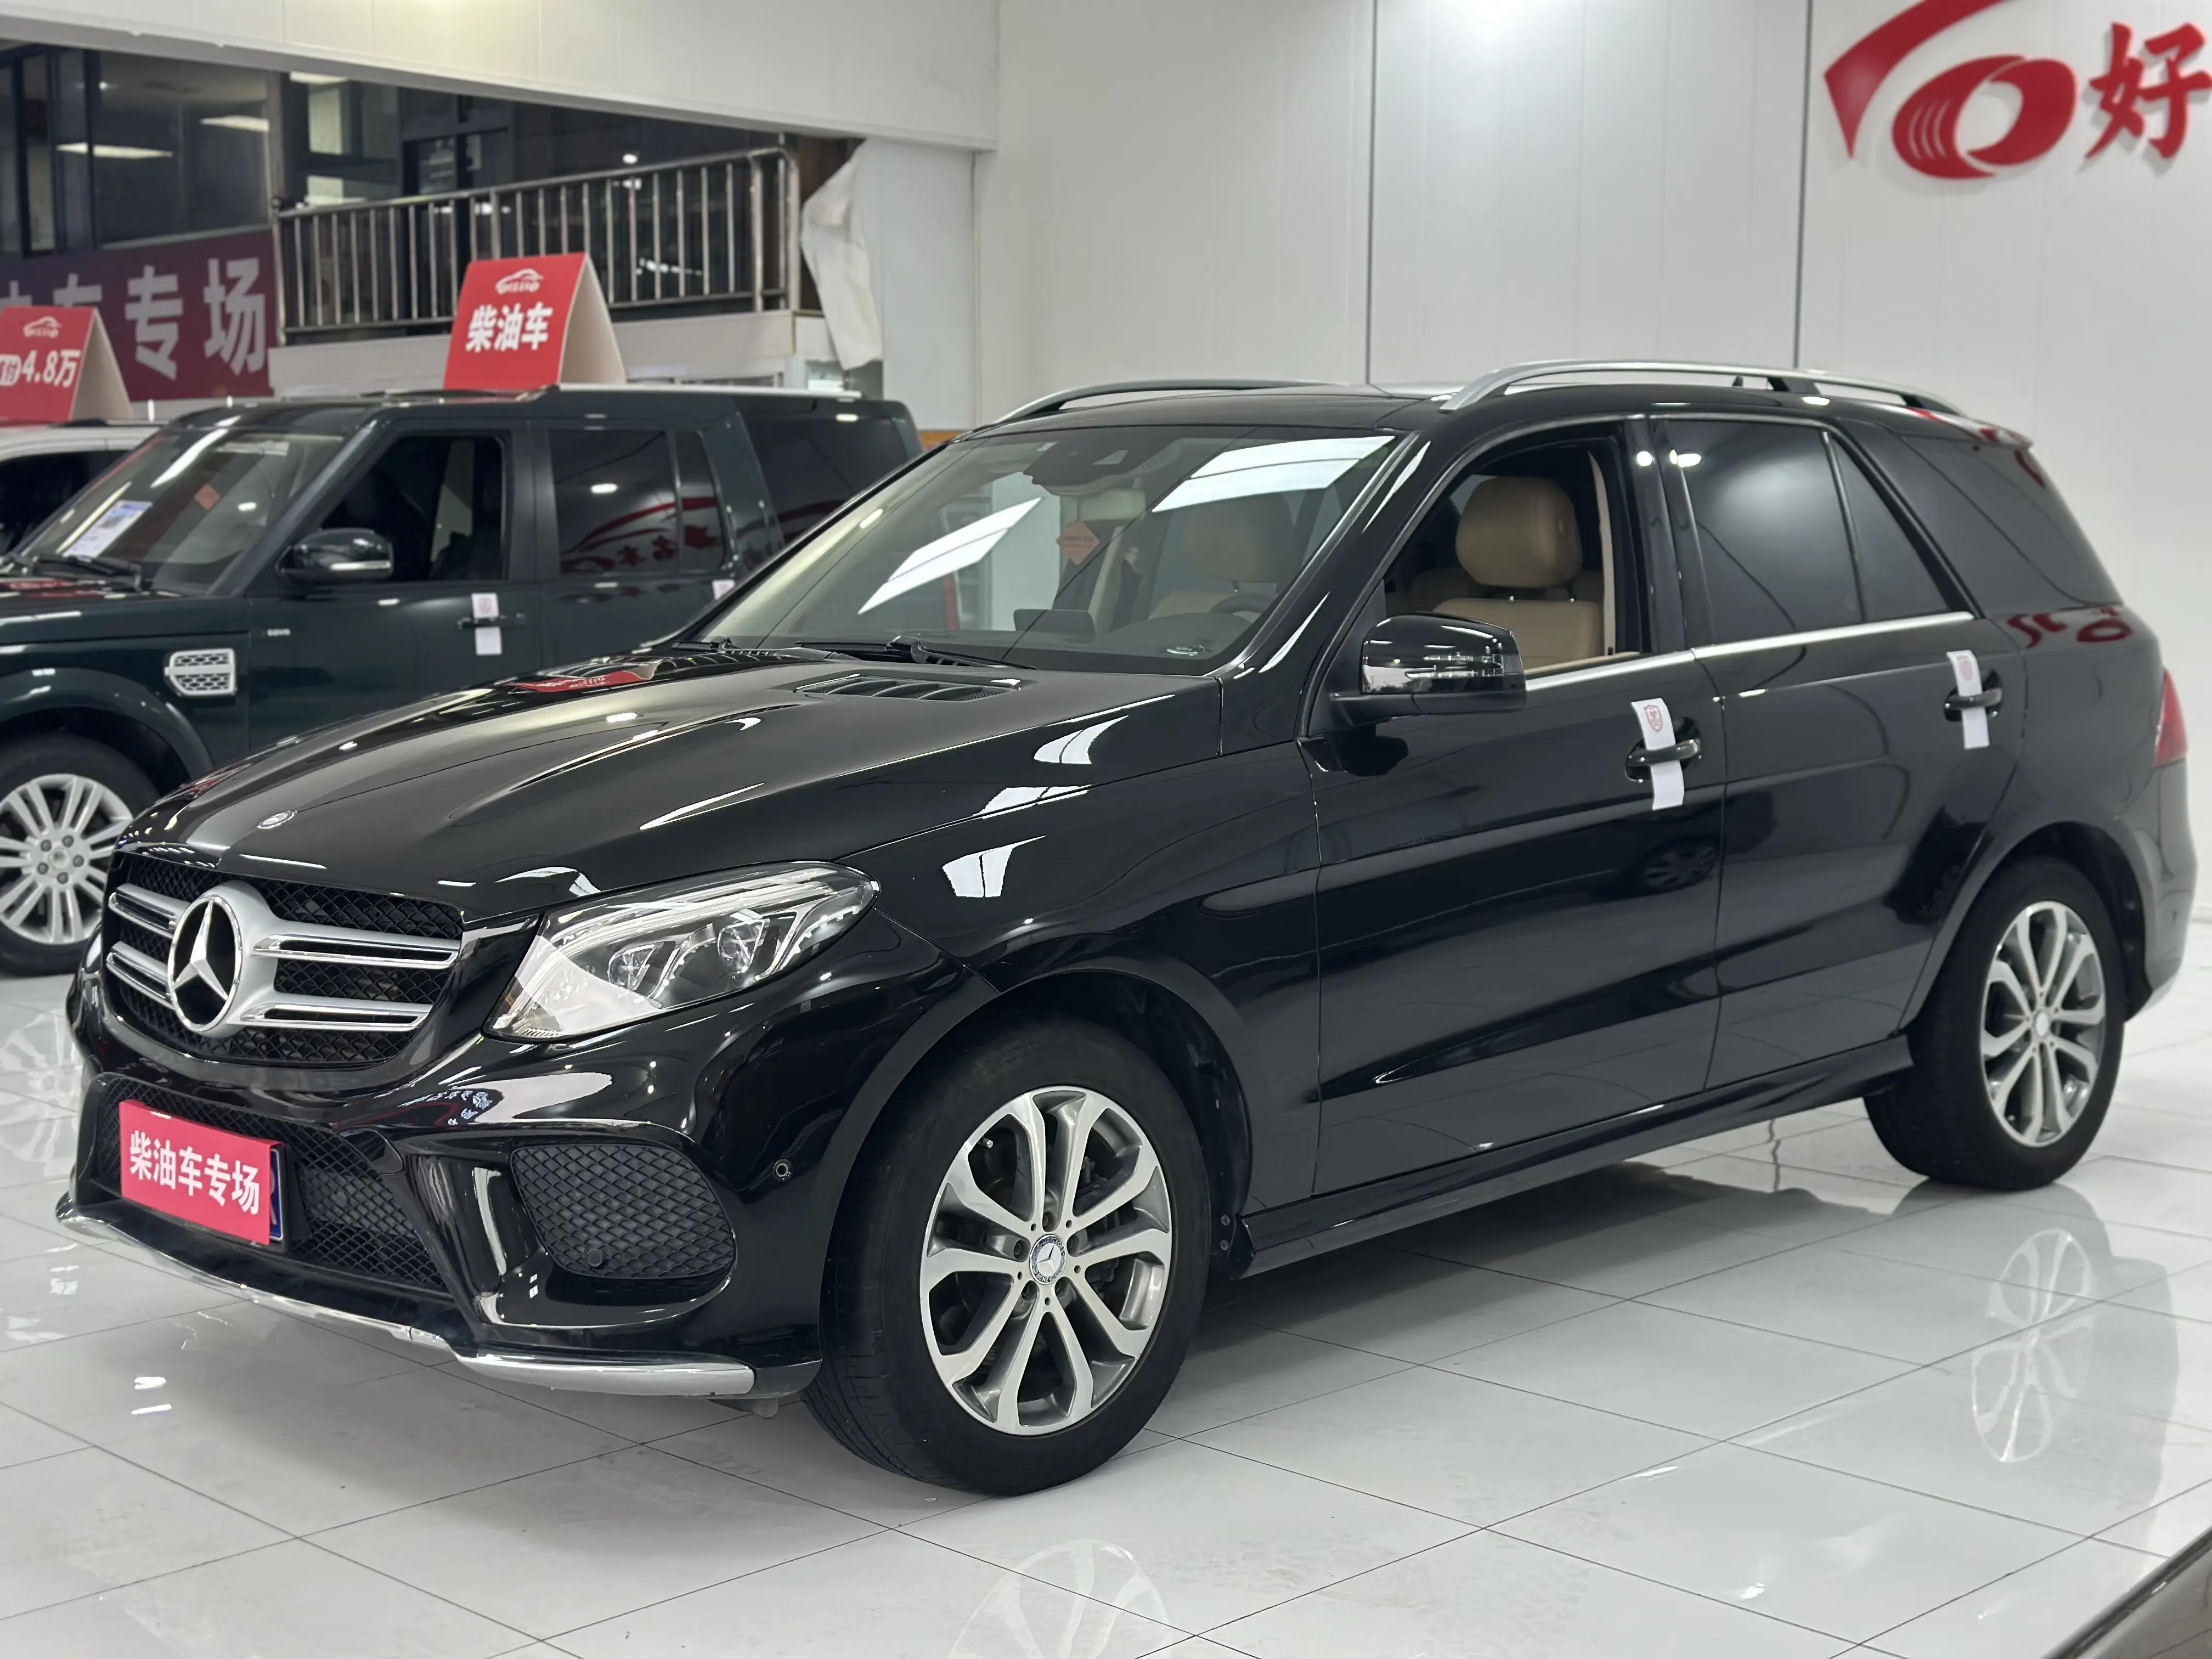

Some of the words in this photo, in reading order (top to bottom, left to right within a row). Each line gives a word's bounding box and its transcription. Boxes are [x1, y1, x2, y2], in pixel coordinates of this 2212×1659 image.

[2084, 21, 2212, 161] 好
[466, 301, 553, 353] 柴油车
[130, 1130, 260, 1215] 柴油车专场
